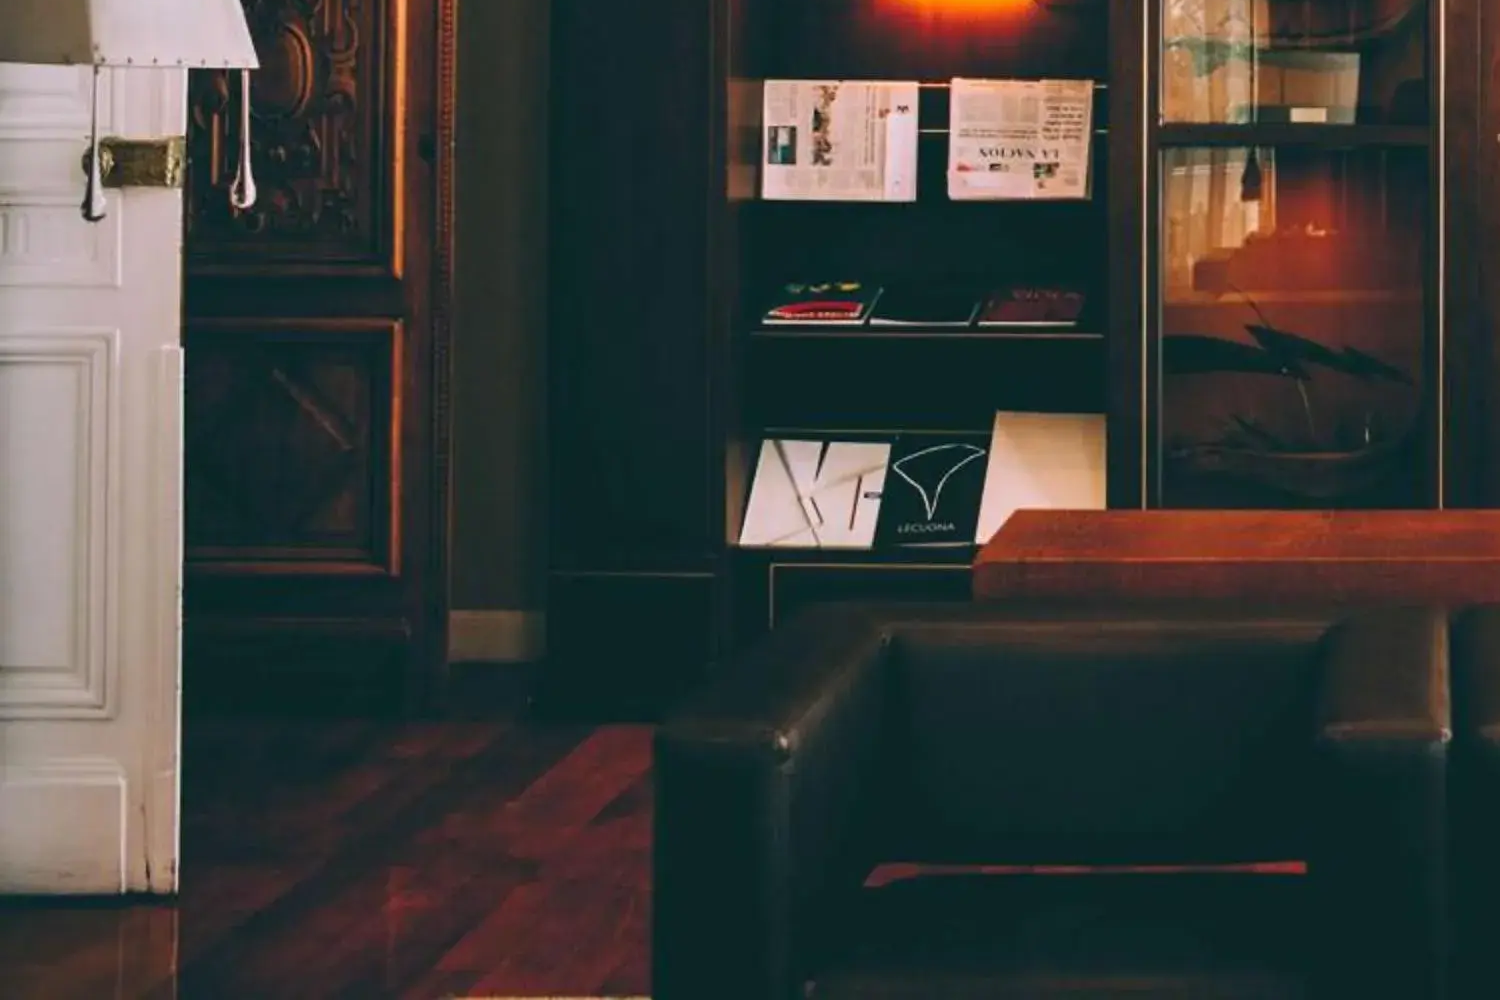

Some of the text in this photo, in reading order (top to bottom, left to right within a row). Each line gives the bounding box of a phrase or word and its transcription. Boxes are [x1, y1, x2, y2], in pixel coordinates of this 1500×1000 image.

[980, 148, 1059, 159] LA NACION
[897, 522, 955, 534] LECUONA
